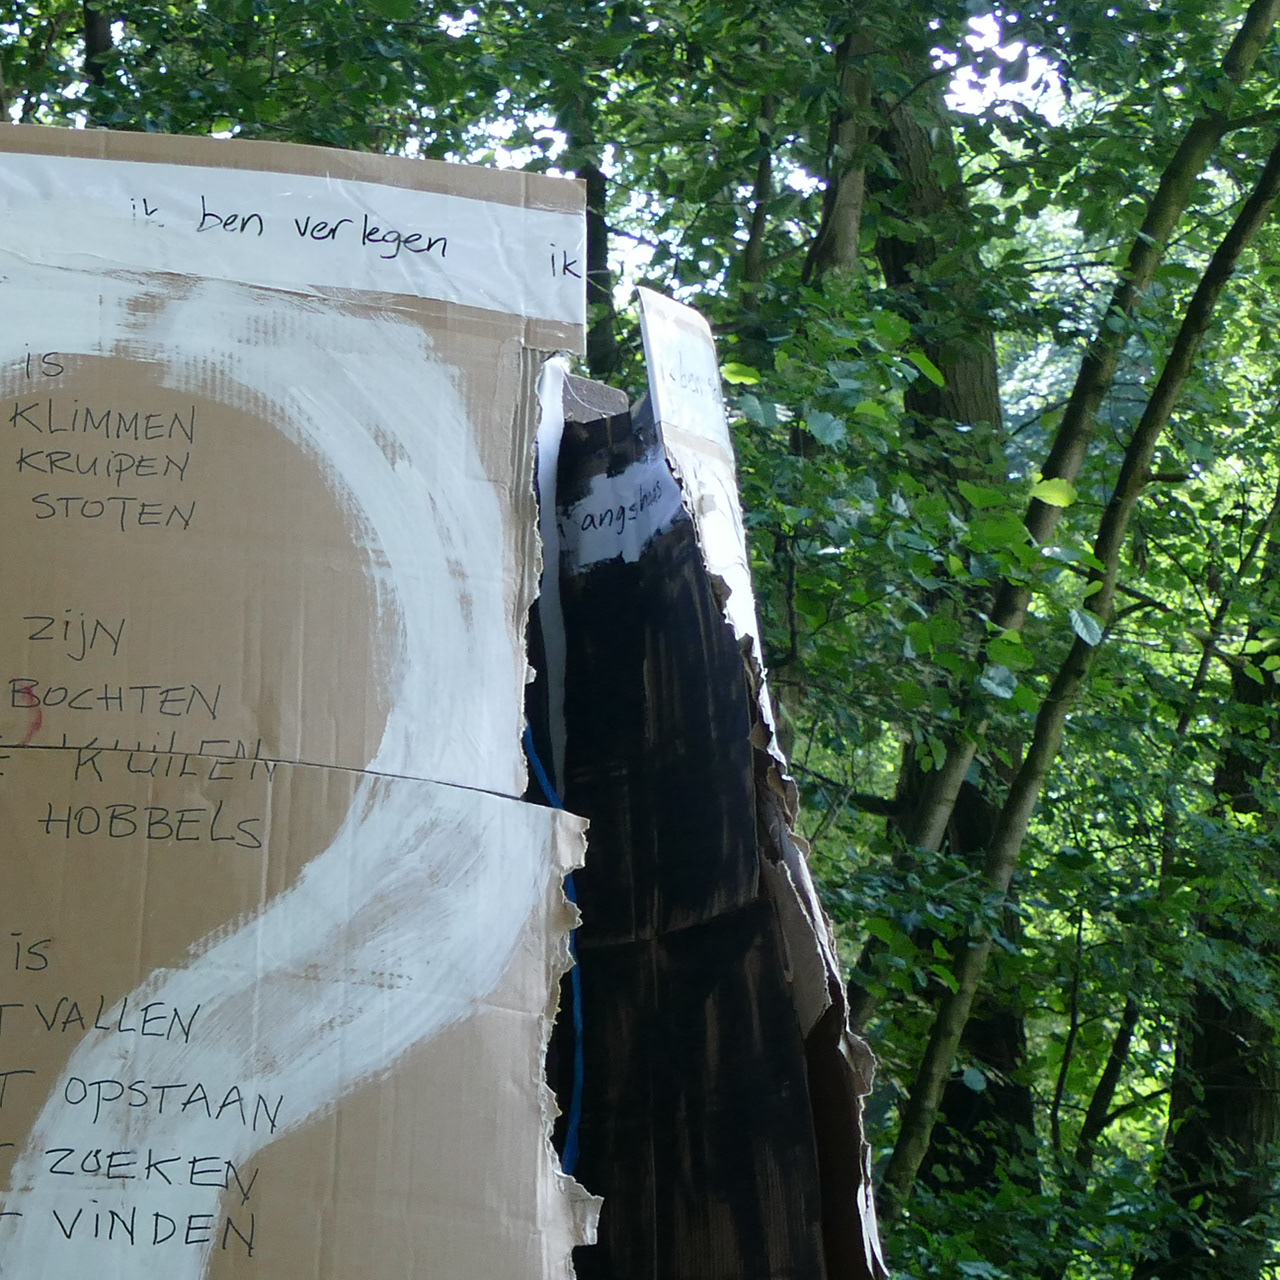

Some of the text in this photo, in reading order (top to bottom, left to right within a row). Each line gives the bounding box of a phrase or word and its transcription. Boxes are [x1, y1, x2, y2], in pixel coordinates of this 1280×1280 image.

[198, 195, 264, 237] ben
[293, 213, 449, 260] verlegen
[550, 243, 583, 279] ik
[31, 493, 196, 532] STOTEN
[9, 677, 222, 720] BOCHTEN
[38, 799, 263, 849] HOBBELS
[35, 995, 201, 1044] VALLEN
[64, 1077, 284, 1135] OPSTAAN
[45, 1148, 259, 1206] ZOEKEN
